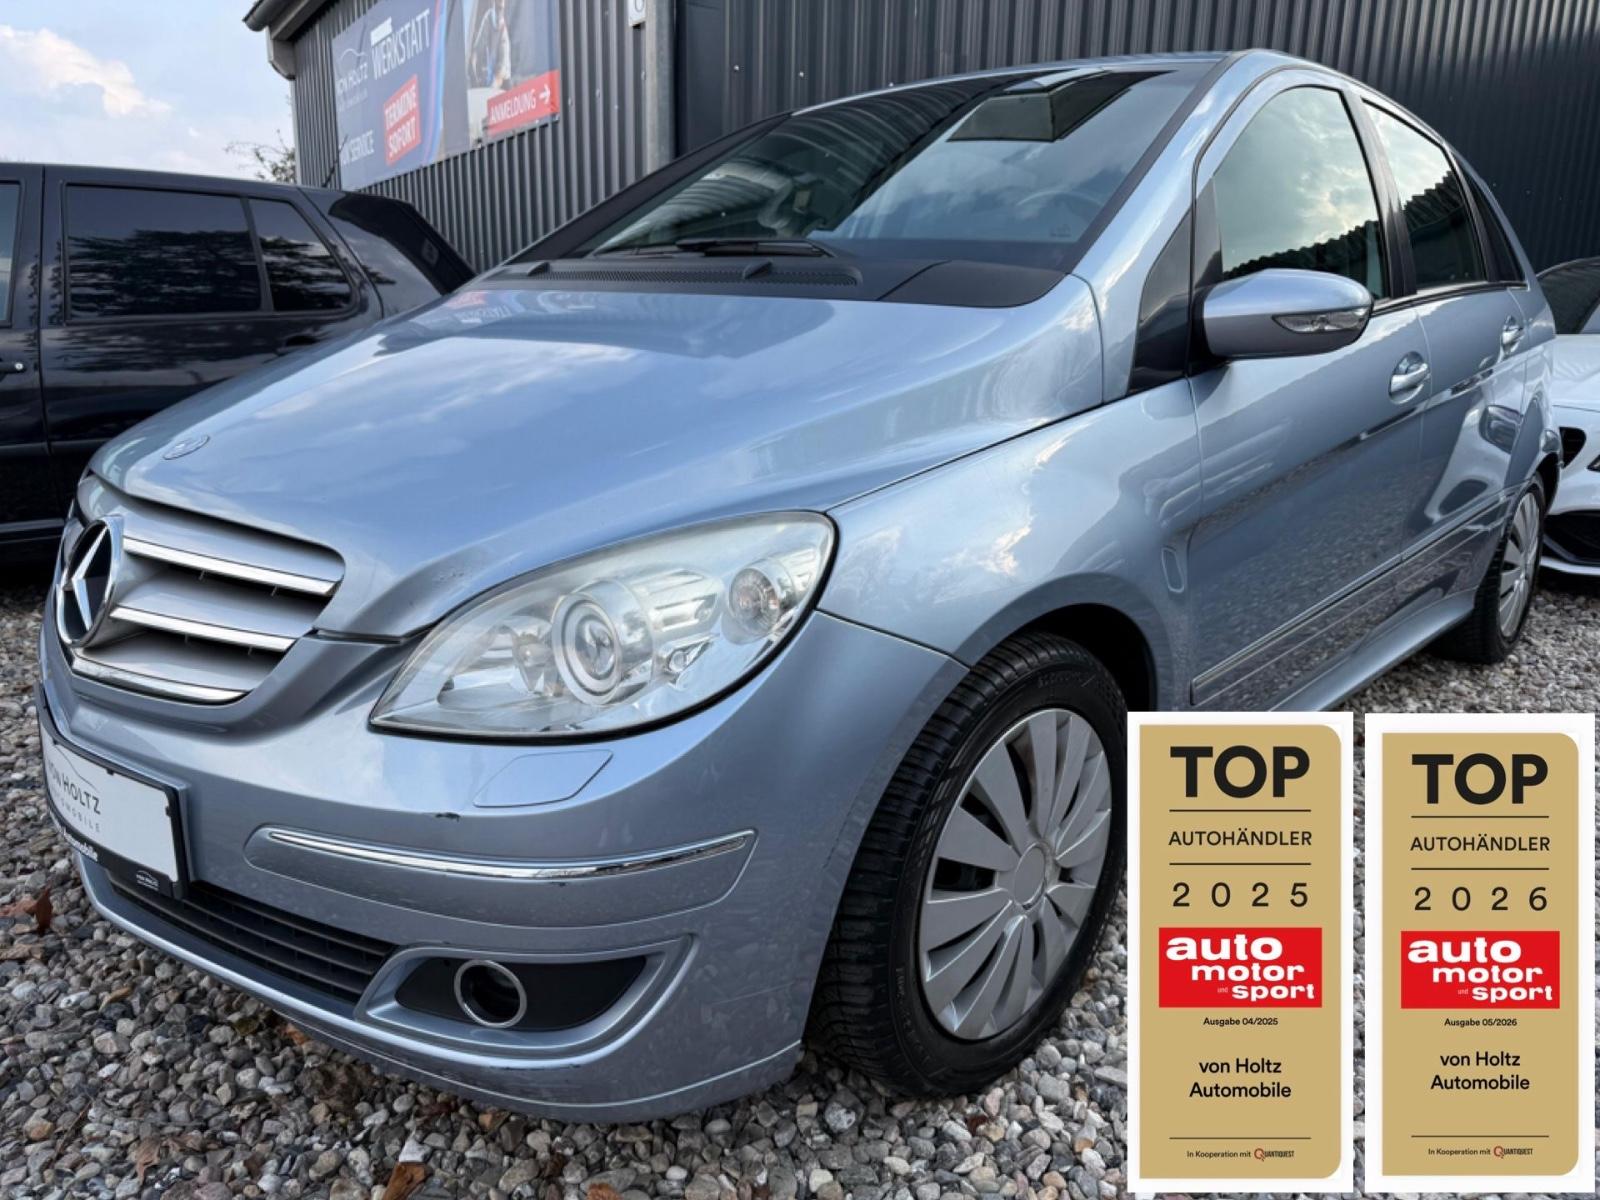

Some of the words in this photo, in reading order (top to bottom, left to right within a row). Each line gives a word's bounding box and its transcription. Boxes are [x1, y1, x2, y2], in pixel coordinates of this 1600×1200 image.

[371, 9, 430, 80] WERKSTATT
[490, 88, 536, 124] ANMELDUNG
[389, 116, 416, 157] SOFORT
[62, 772, 101, 816] HOLTZ
